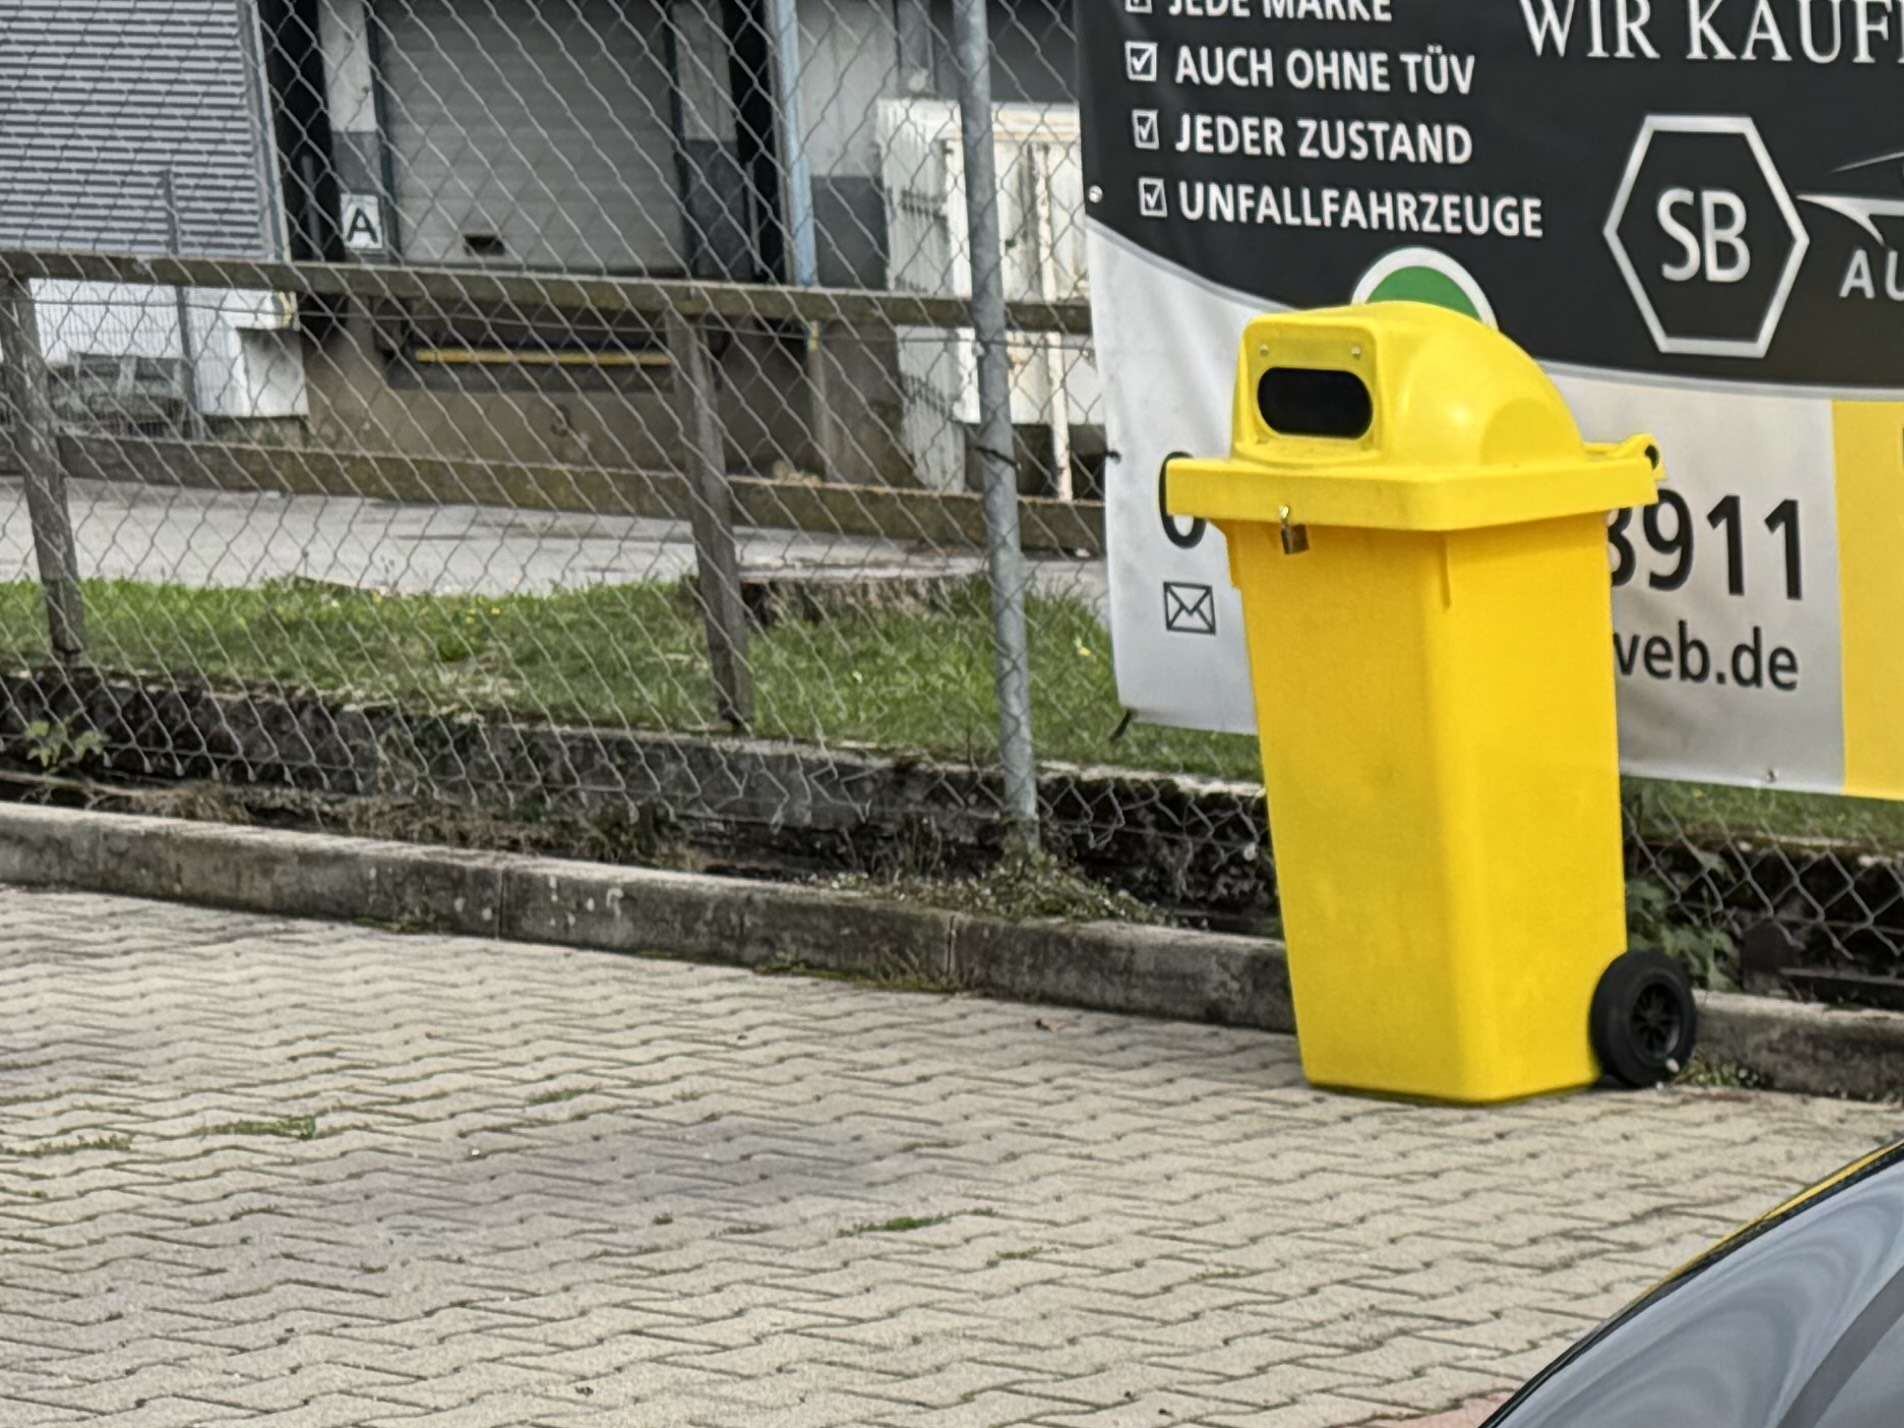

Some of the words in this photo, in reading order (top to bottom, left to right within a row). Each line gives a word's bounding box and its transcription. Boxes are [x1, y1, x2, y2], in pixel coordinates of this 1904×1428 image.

[1522, 0, 1660, 62] WIR
[1175, 45, 1274, 88] AUCH
[1286, 49, 1391, 92] OHNE
[1401, 44, 1476, 96] TÜV
[1174, 113, 1286, 157] JEDER
[1298, 118, 1474, 164] ZUSTAND
[346, 207, 379, 244] A
[1178, 180, 1544, 239] UNFALLFAHRZEUGE
[1656, 188, 1751, 284] SB
